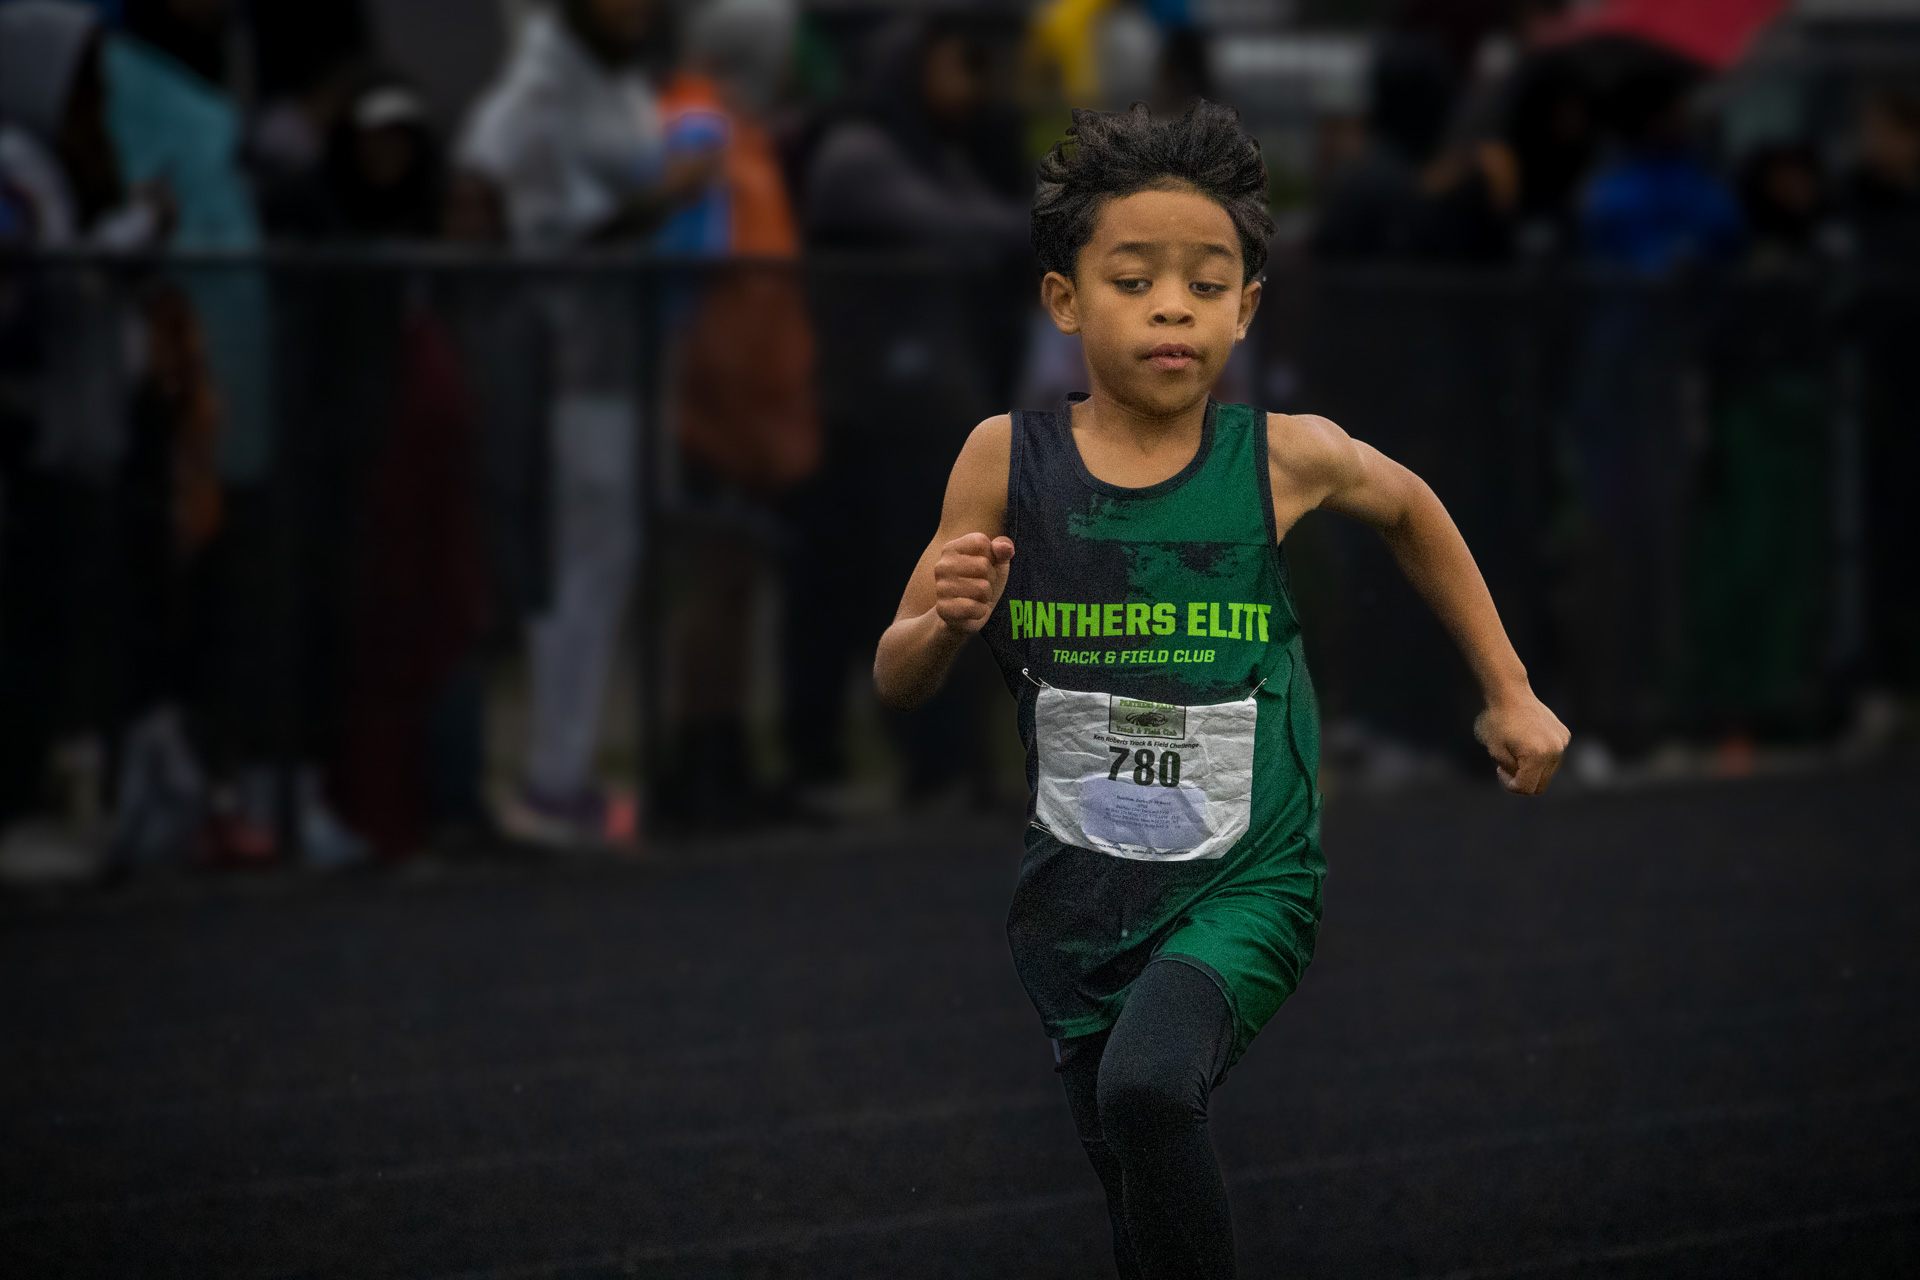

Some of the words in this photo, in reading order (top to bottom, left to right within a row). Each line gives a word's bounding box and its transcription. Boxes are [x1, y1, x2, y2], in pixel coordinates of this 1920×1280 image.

[1009, 600, 1176, 639] PANTHERS
[1053, 649, 1100, 664] TRACK
[1104, 650, 1117, 664] &
[1120, 650, 1168, 664] FIELD
[1173, 649, 1215, 663] CLUB
[1116, 725, 1134, 734] Track
[1143, 727, 1161, 735] Field
[1163, 728, 1178, 736] Club
[1093, 734, 1105, 742] Ken
[1105, 736, 1128, 746] Roberts
[1129, 739, 1147, 747] Track
[1169, 742, 1200, 750] Challenge
[1107, 745, 1181, 788] 780
